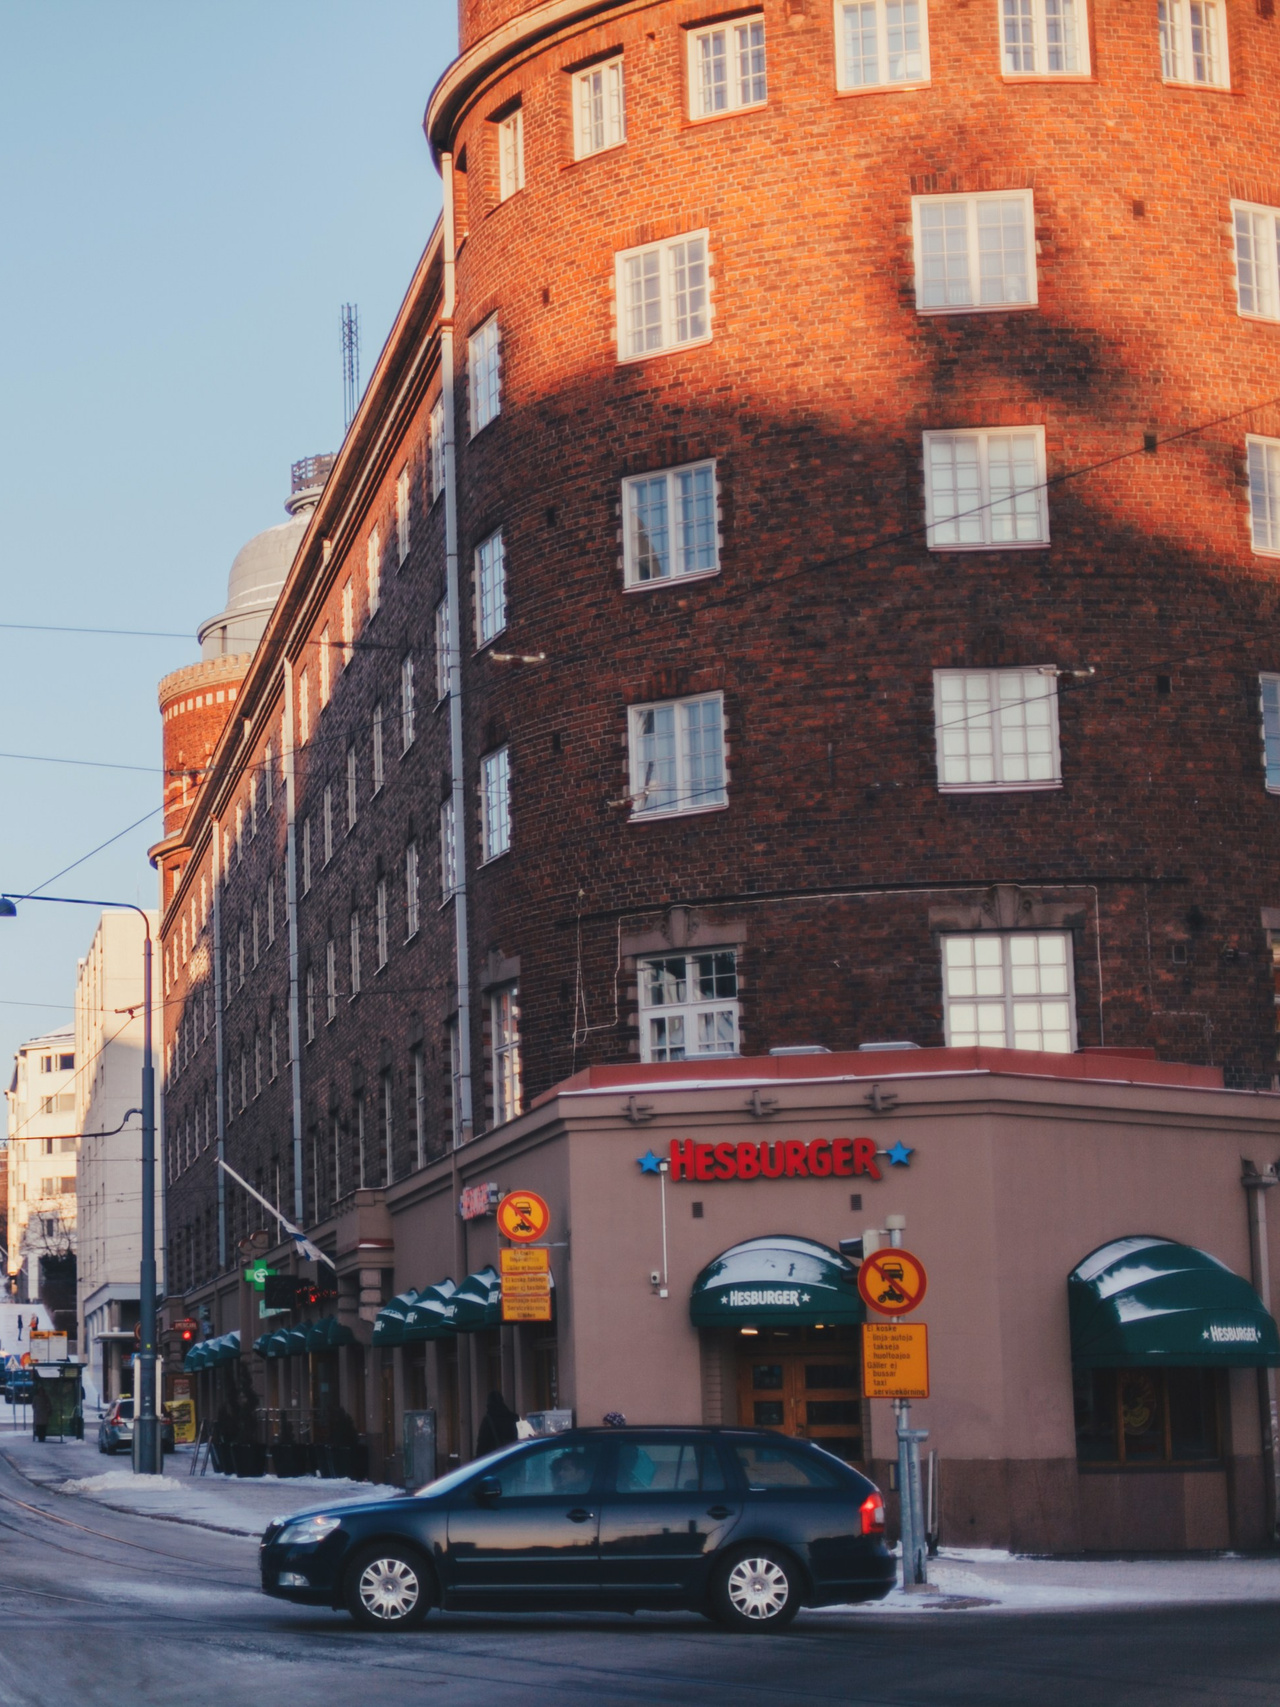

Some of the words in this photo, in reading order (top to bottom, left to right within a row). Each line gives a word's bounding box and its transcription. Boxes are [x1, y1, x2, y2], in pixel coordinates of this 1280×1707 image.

[670, 1137, 883, 1182] HESBURGER
[729, 1290, 801, 1307] HESBURGER
[876, 1324, 897, 1332] koske
[872, 1334, 913, 1342] linja-autoja
[1210, 1325, 1259, 1344] HESBURGER
[873, 1343, 900, 1351] takseja
[872, 1370, 896, 1378] bussar
